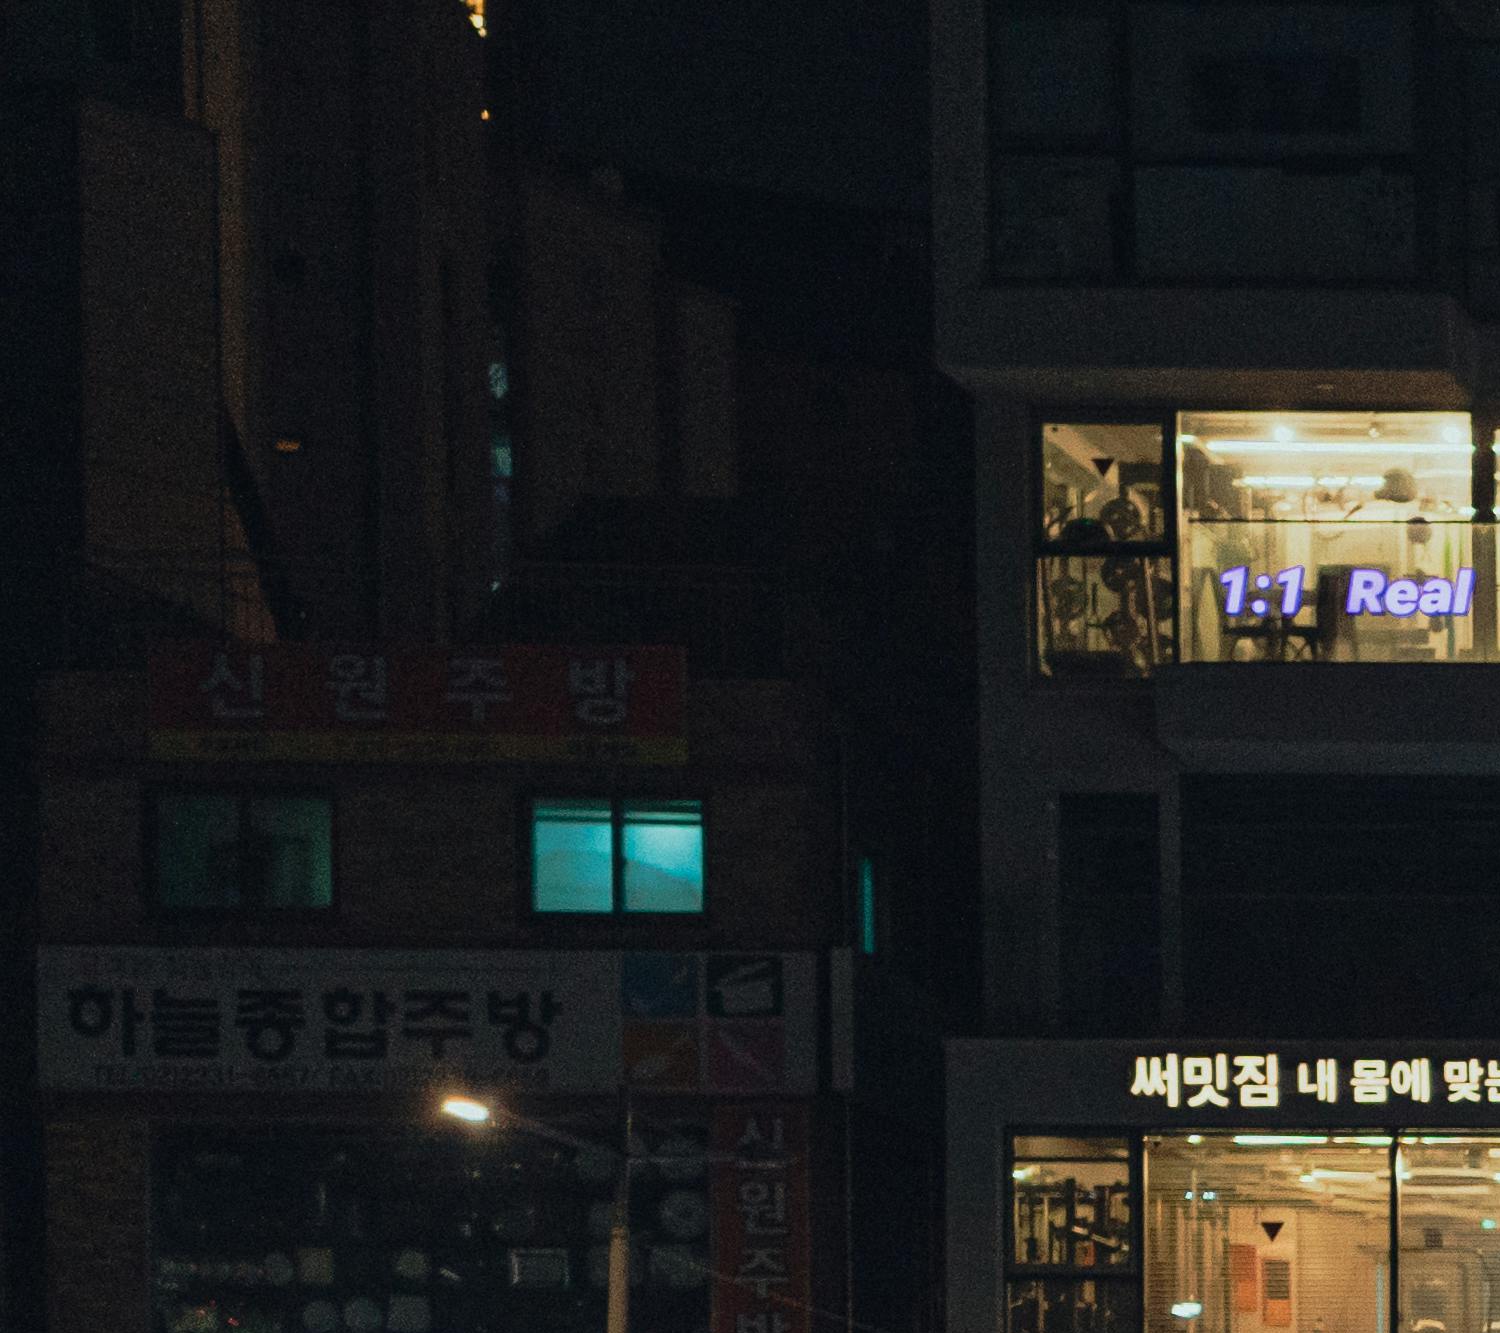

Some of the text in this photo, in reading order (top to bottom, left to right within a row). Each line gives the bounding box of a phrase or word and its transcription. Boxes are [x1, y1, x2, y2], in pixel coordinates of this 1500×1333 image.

[1220, 565, 1304, 617] 1:1
[1346, 567, 1476, 617] Real
[201, 653, 634, 726] 신원주방
[67, 986, 562, 1063] 하늘종합주방
[1131, 1053, 1280, 1107] 써밋짐
[1297, 1061, 1336, 1103] 내
[1350, 1059, 1430, 1103] 몸에
